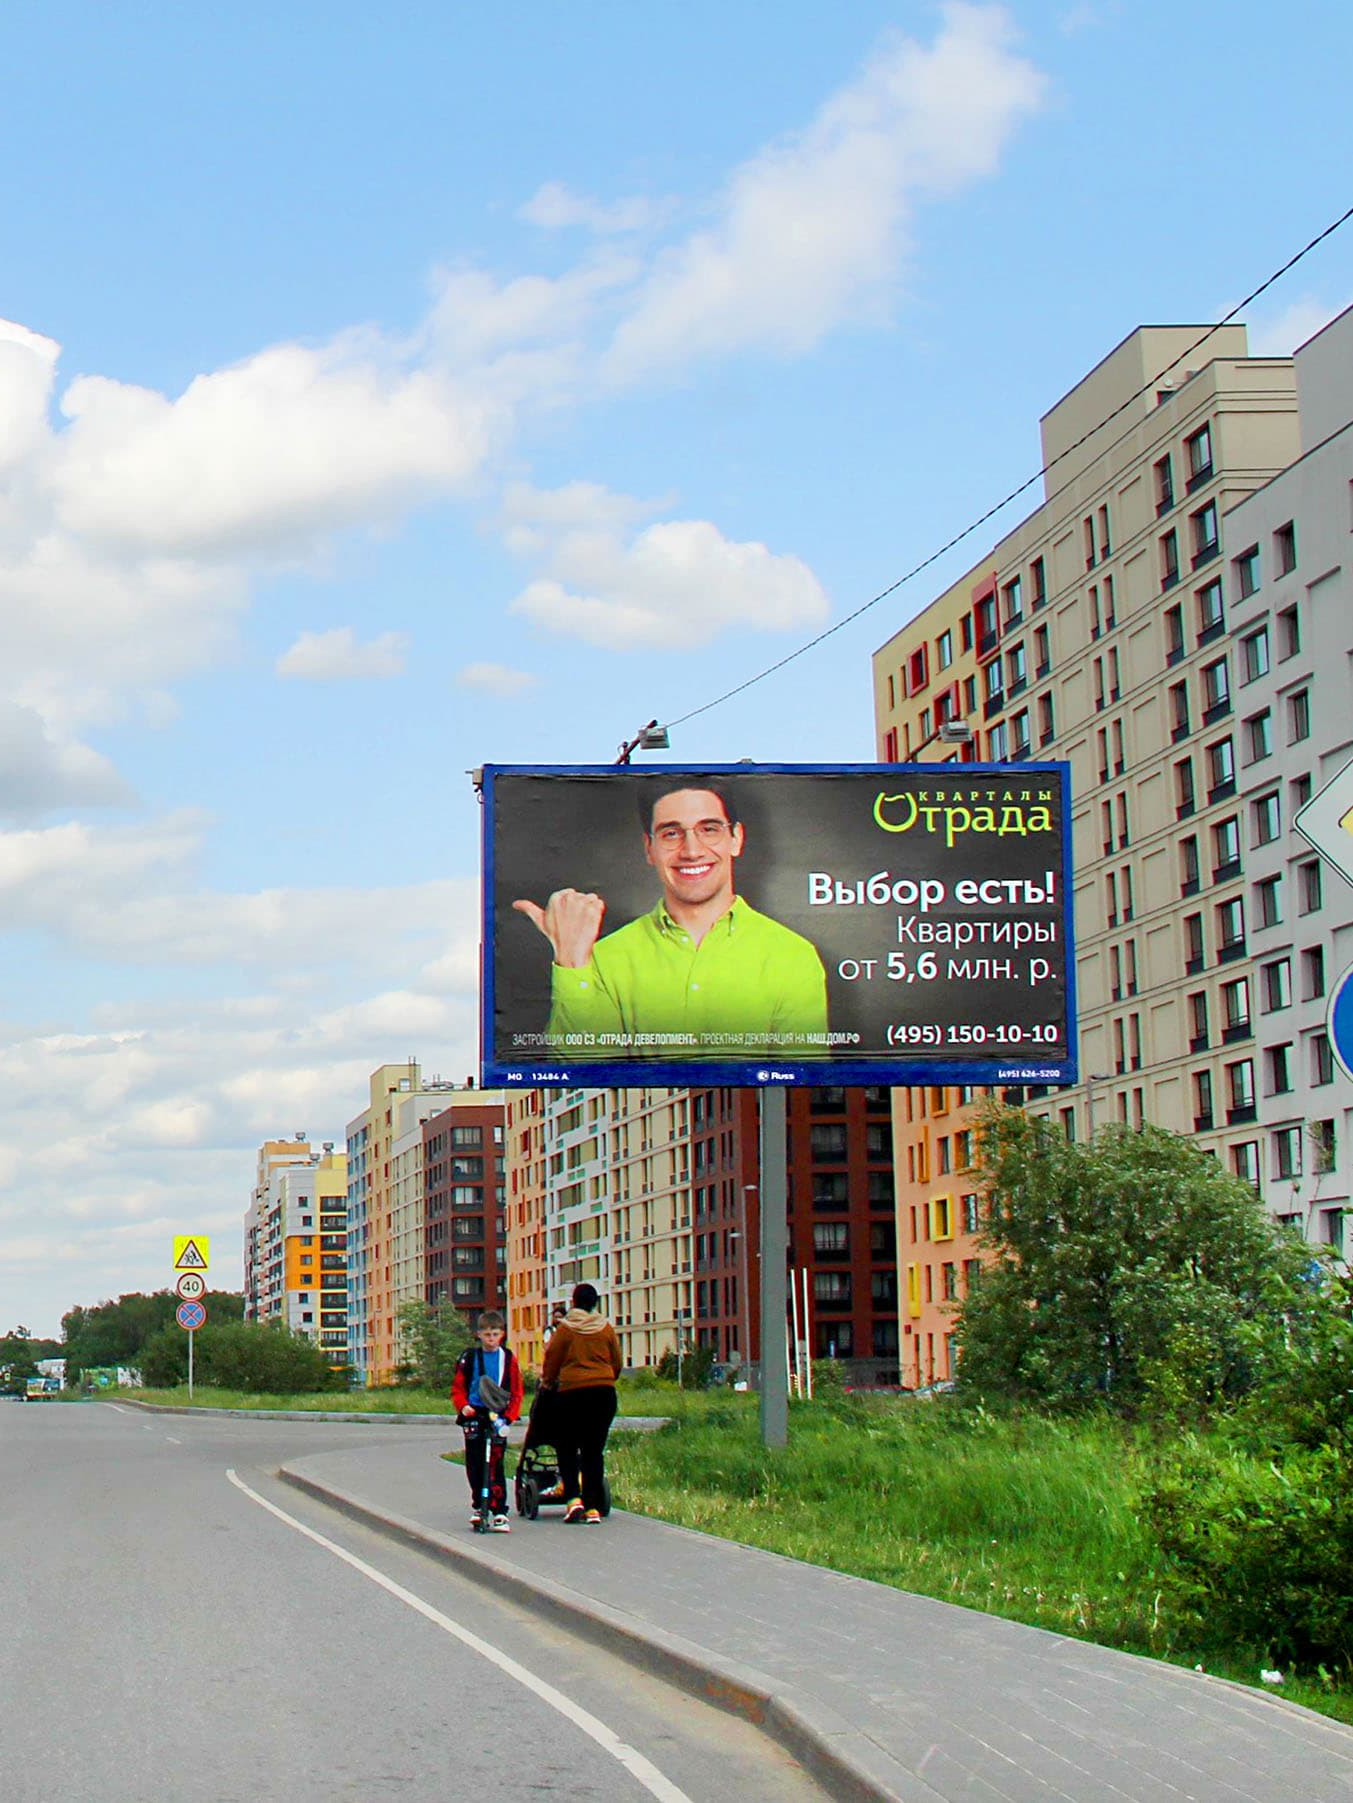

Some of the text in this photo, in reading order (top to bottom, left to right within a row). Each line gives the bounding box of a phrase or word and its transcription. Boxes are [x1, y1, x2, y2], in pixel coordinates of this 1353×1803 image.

[918, 791, 1052, 801] КВАРТАЛЫ
[873, 792, 1053, 847] Отрада
[808, 871, 1055, 912] Выбор есть!
[897, 915, 1056, 949] Квартиры
[838, 951, 1057, 986] от 5,6 млн. р.
[565, 1033, 583, 1046] ООО
[584, 1033, 596, 1046] СЗ
[887, 1024, 1058, 1046] (495) 150-10-10
[771, 1071, 795, 1080] Russ
[182, 1281, 199, 1292] 40
